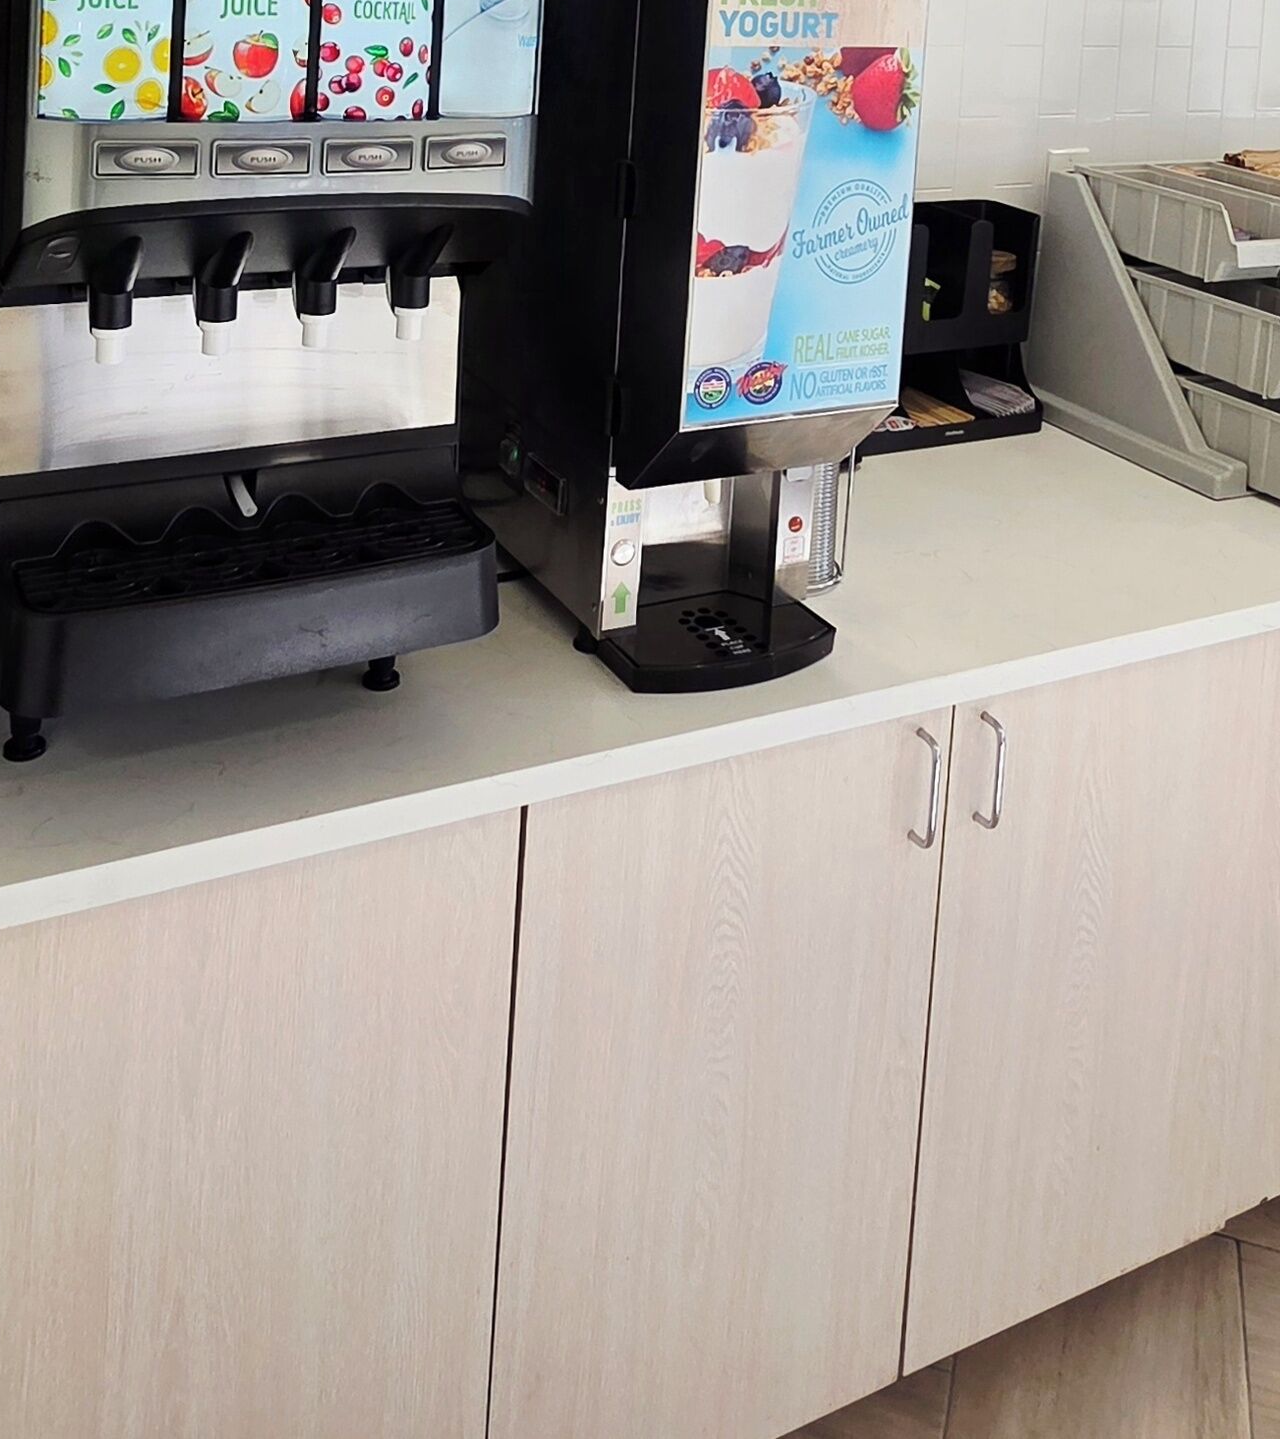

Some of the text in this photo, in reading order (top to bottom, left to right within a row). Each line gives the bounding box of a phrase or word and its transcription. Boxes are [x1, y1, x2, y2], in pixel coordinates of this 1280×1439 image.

[354, 0, 416, 24] COCKTAIL
[719, 10, 839, 39] YOGURT
[821, 183, 885, 217] PREMIUM QUALITY
[792, 193, 908, 259] Farmer Owned
[834, 237, 879, 261] creamery
[794, 333, 834, 363] REAL
[837, 329, 860, 343] CANE
[790, 371, 817, 400] NO
[820, 368, 853, 383] GLUTEN
[855, 367, 868, 380] OR
[611, 499, 641, 514] PRESS
